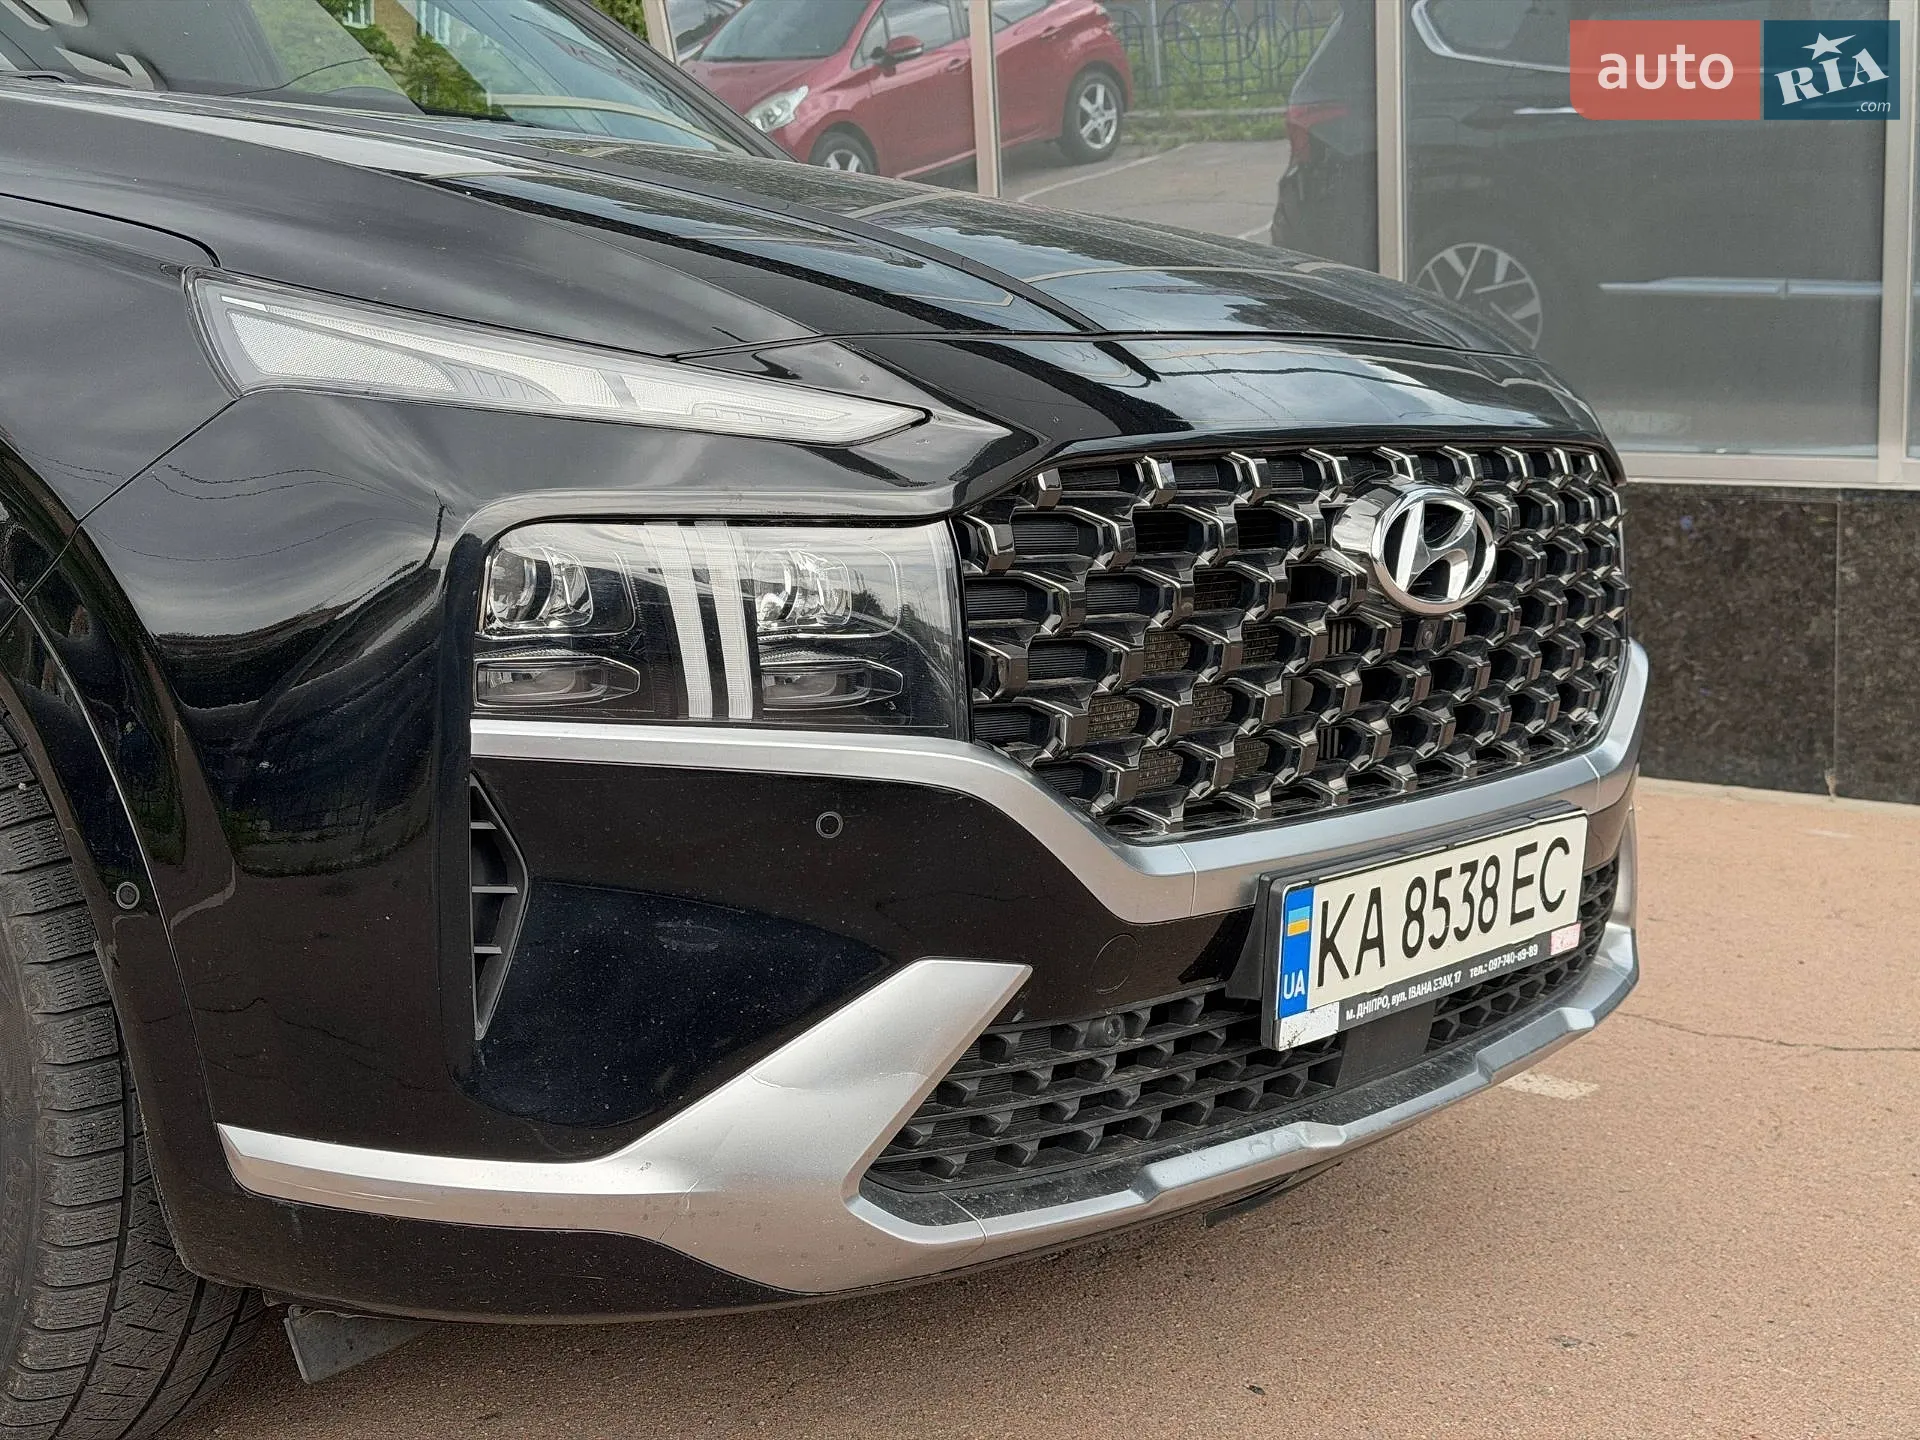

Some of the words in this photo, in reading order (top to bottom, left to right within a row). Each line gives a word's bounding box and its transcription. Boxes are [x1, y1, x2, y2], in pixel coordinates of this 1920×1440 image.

[1316, 886, 1386, 988] KA
[1401, 854, 1501, 959] 8538
[1510, 836, 1571, 927] EC
[1283, 969, 1306, 1000] UA
[1356, 995, 1391, 1019] ДНІПРО,
[1391, 991, 1408, 1007] вул.
[1408, 980, 1433, 1000] ІВАНА
[1453, 970, 1462, 983] 17
